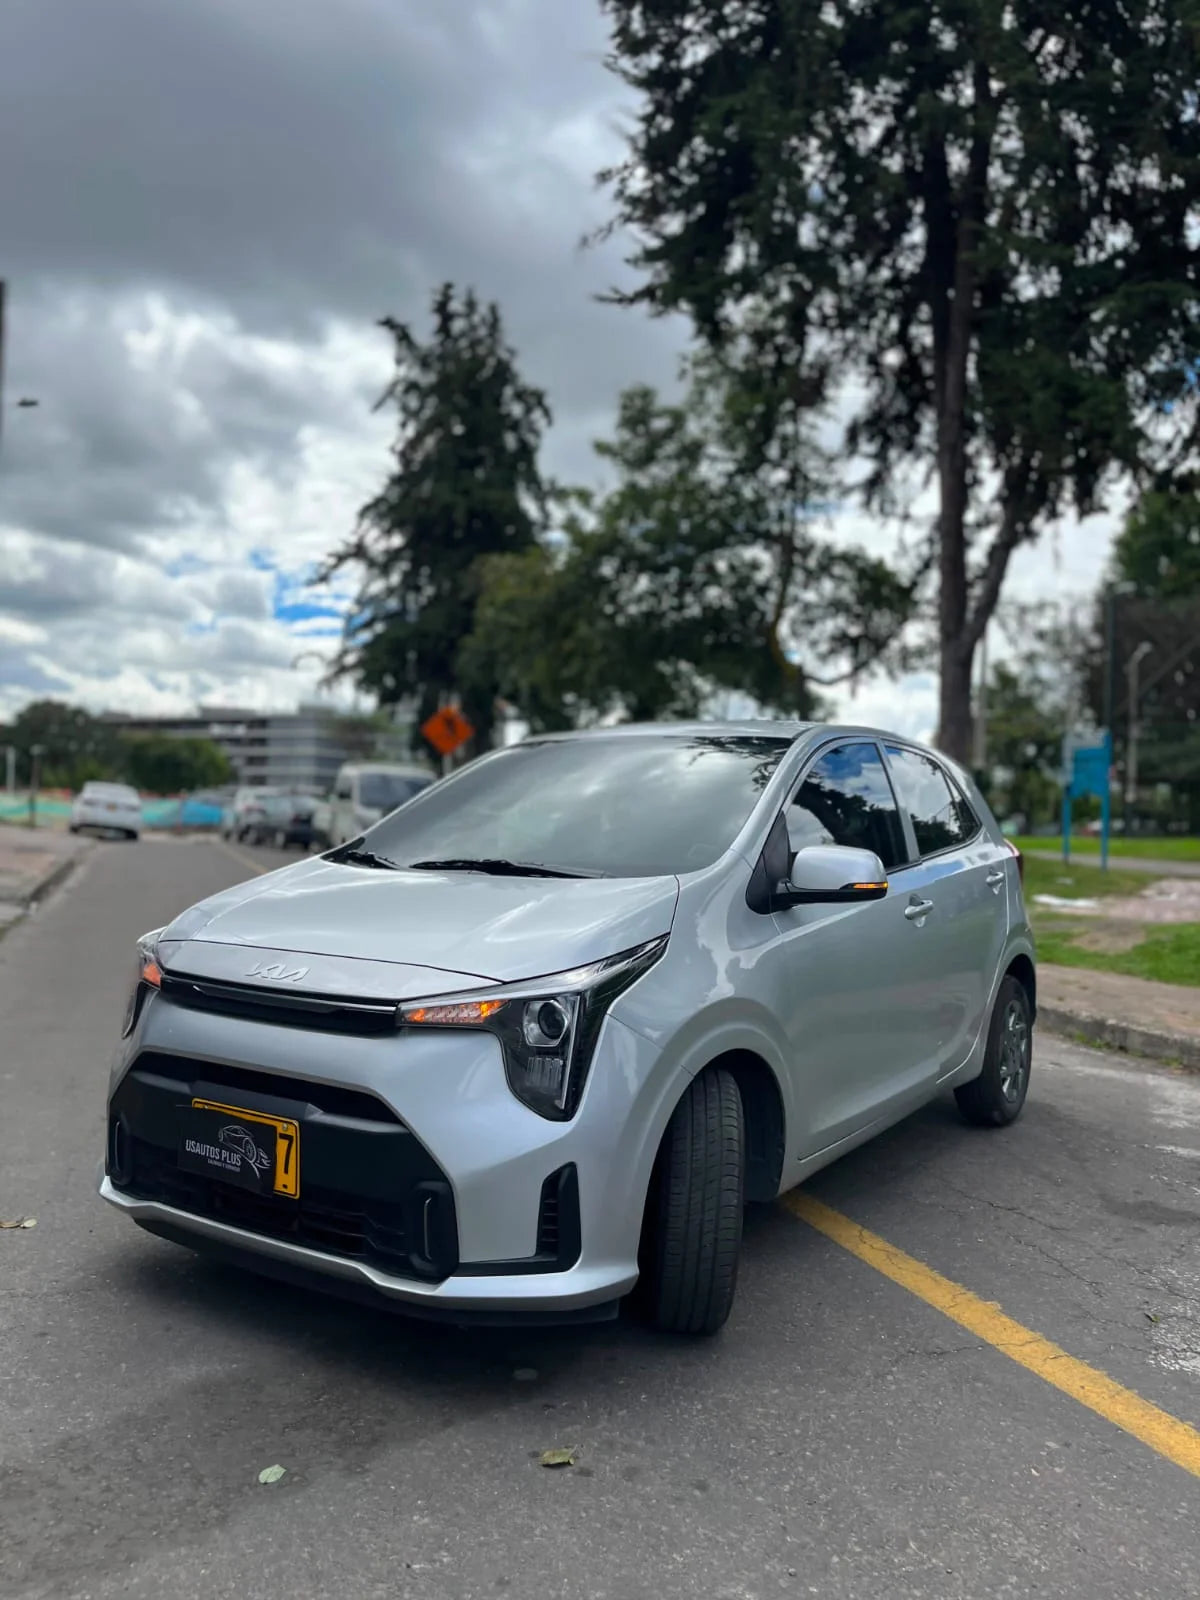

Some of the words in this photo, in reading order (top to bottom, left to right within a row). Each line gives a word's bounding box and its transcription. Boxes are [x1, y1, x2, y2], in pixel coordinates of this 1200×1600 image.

[185, 1139, 220, 1160] USAUTOS
[221, 1150, 241, 1166] PLUS
[278, 1132, 294, 1175] 7
